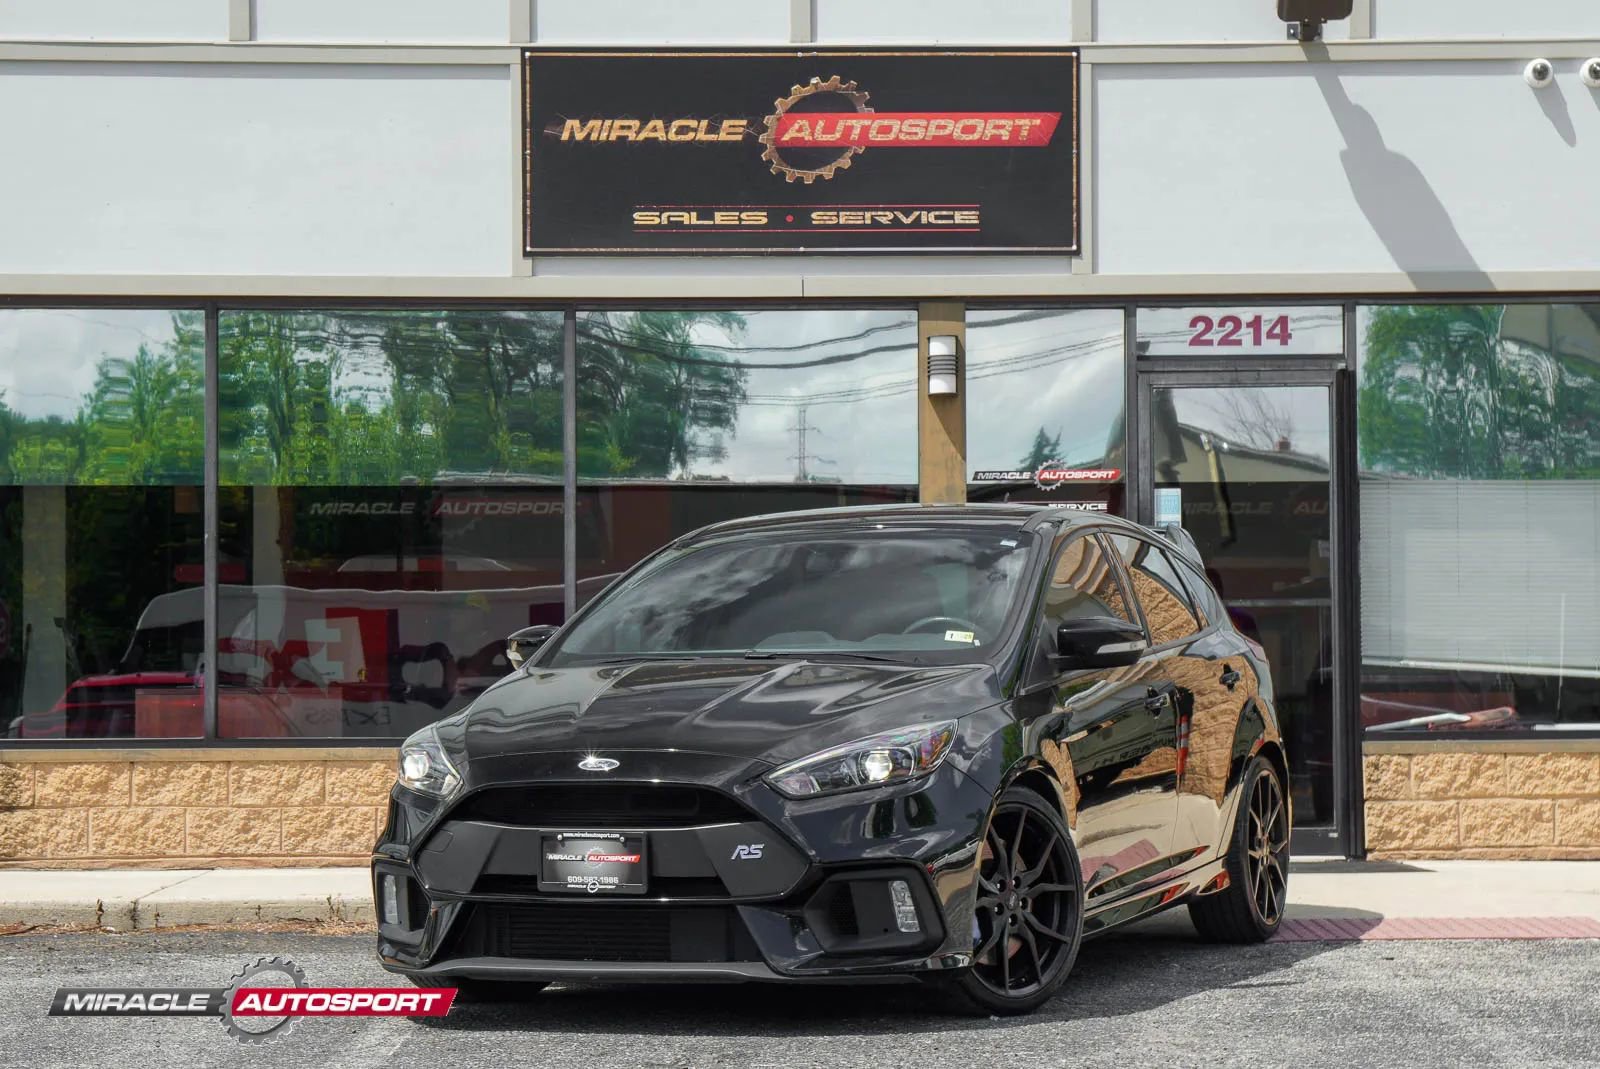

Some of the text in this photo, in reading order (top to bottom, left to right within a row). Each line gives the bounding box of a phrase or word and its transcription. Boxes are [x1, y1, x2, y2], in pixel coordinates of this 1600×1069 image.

[560, 117, 1043, 142] MIRACLE AUTOSPORT
[632, 211, 981, 225] SALES SERVICE
[1188, 314, 1293, 347] 2214
[977, 470, 1116, 480] MIRACLE AUTOSPORT
[308, 501, 581, 515] MIRACLE AUTOSPOR
[730, 843, 765, 860] RS
